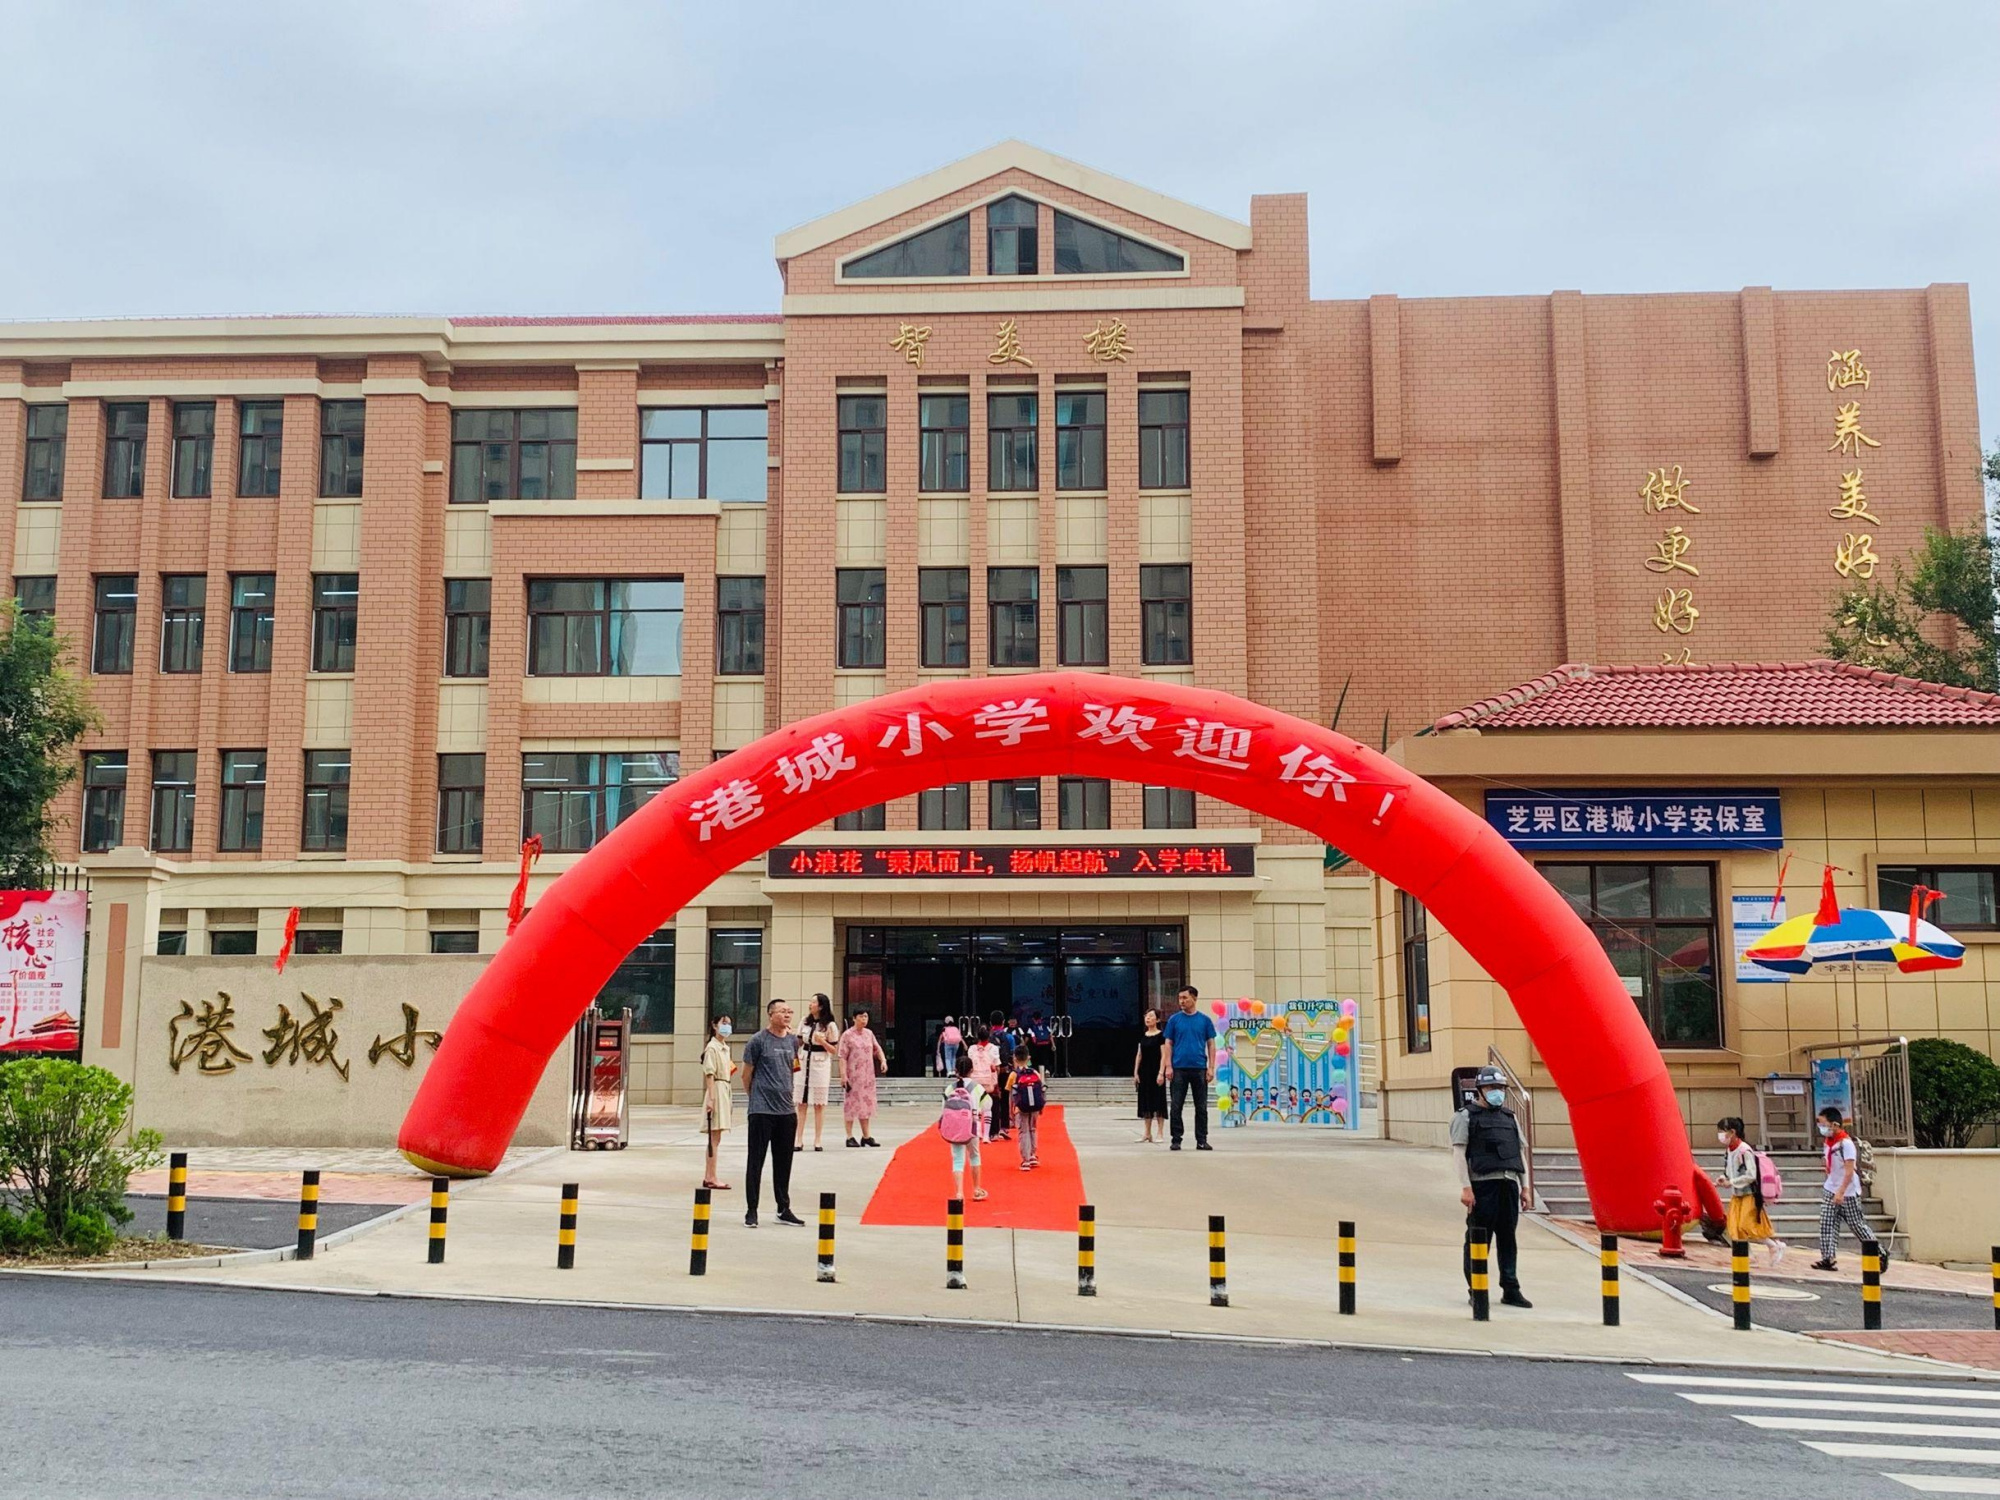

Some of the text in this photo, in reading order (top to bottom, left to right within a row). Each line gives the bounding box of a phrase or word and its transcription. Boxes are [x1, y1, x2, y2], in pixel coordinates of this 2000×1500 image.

[890, 317, 1134, 368] 智美楼
[689, 696, 1396, 842] 港城小学欢迎你！
[1506, 805, 1767, 833] 芝罘区港城小学安保室
